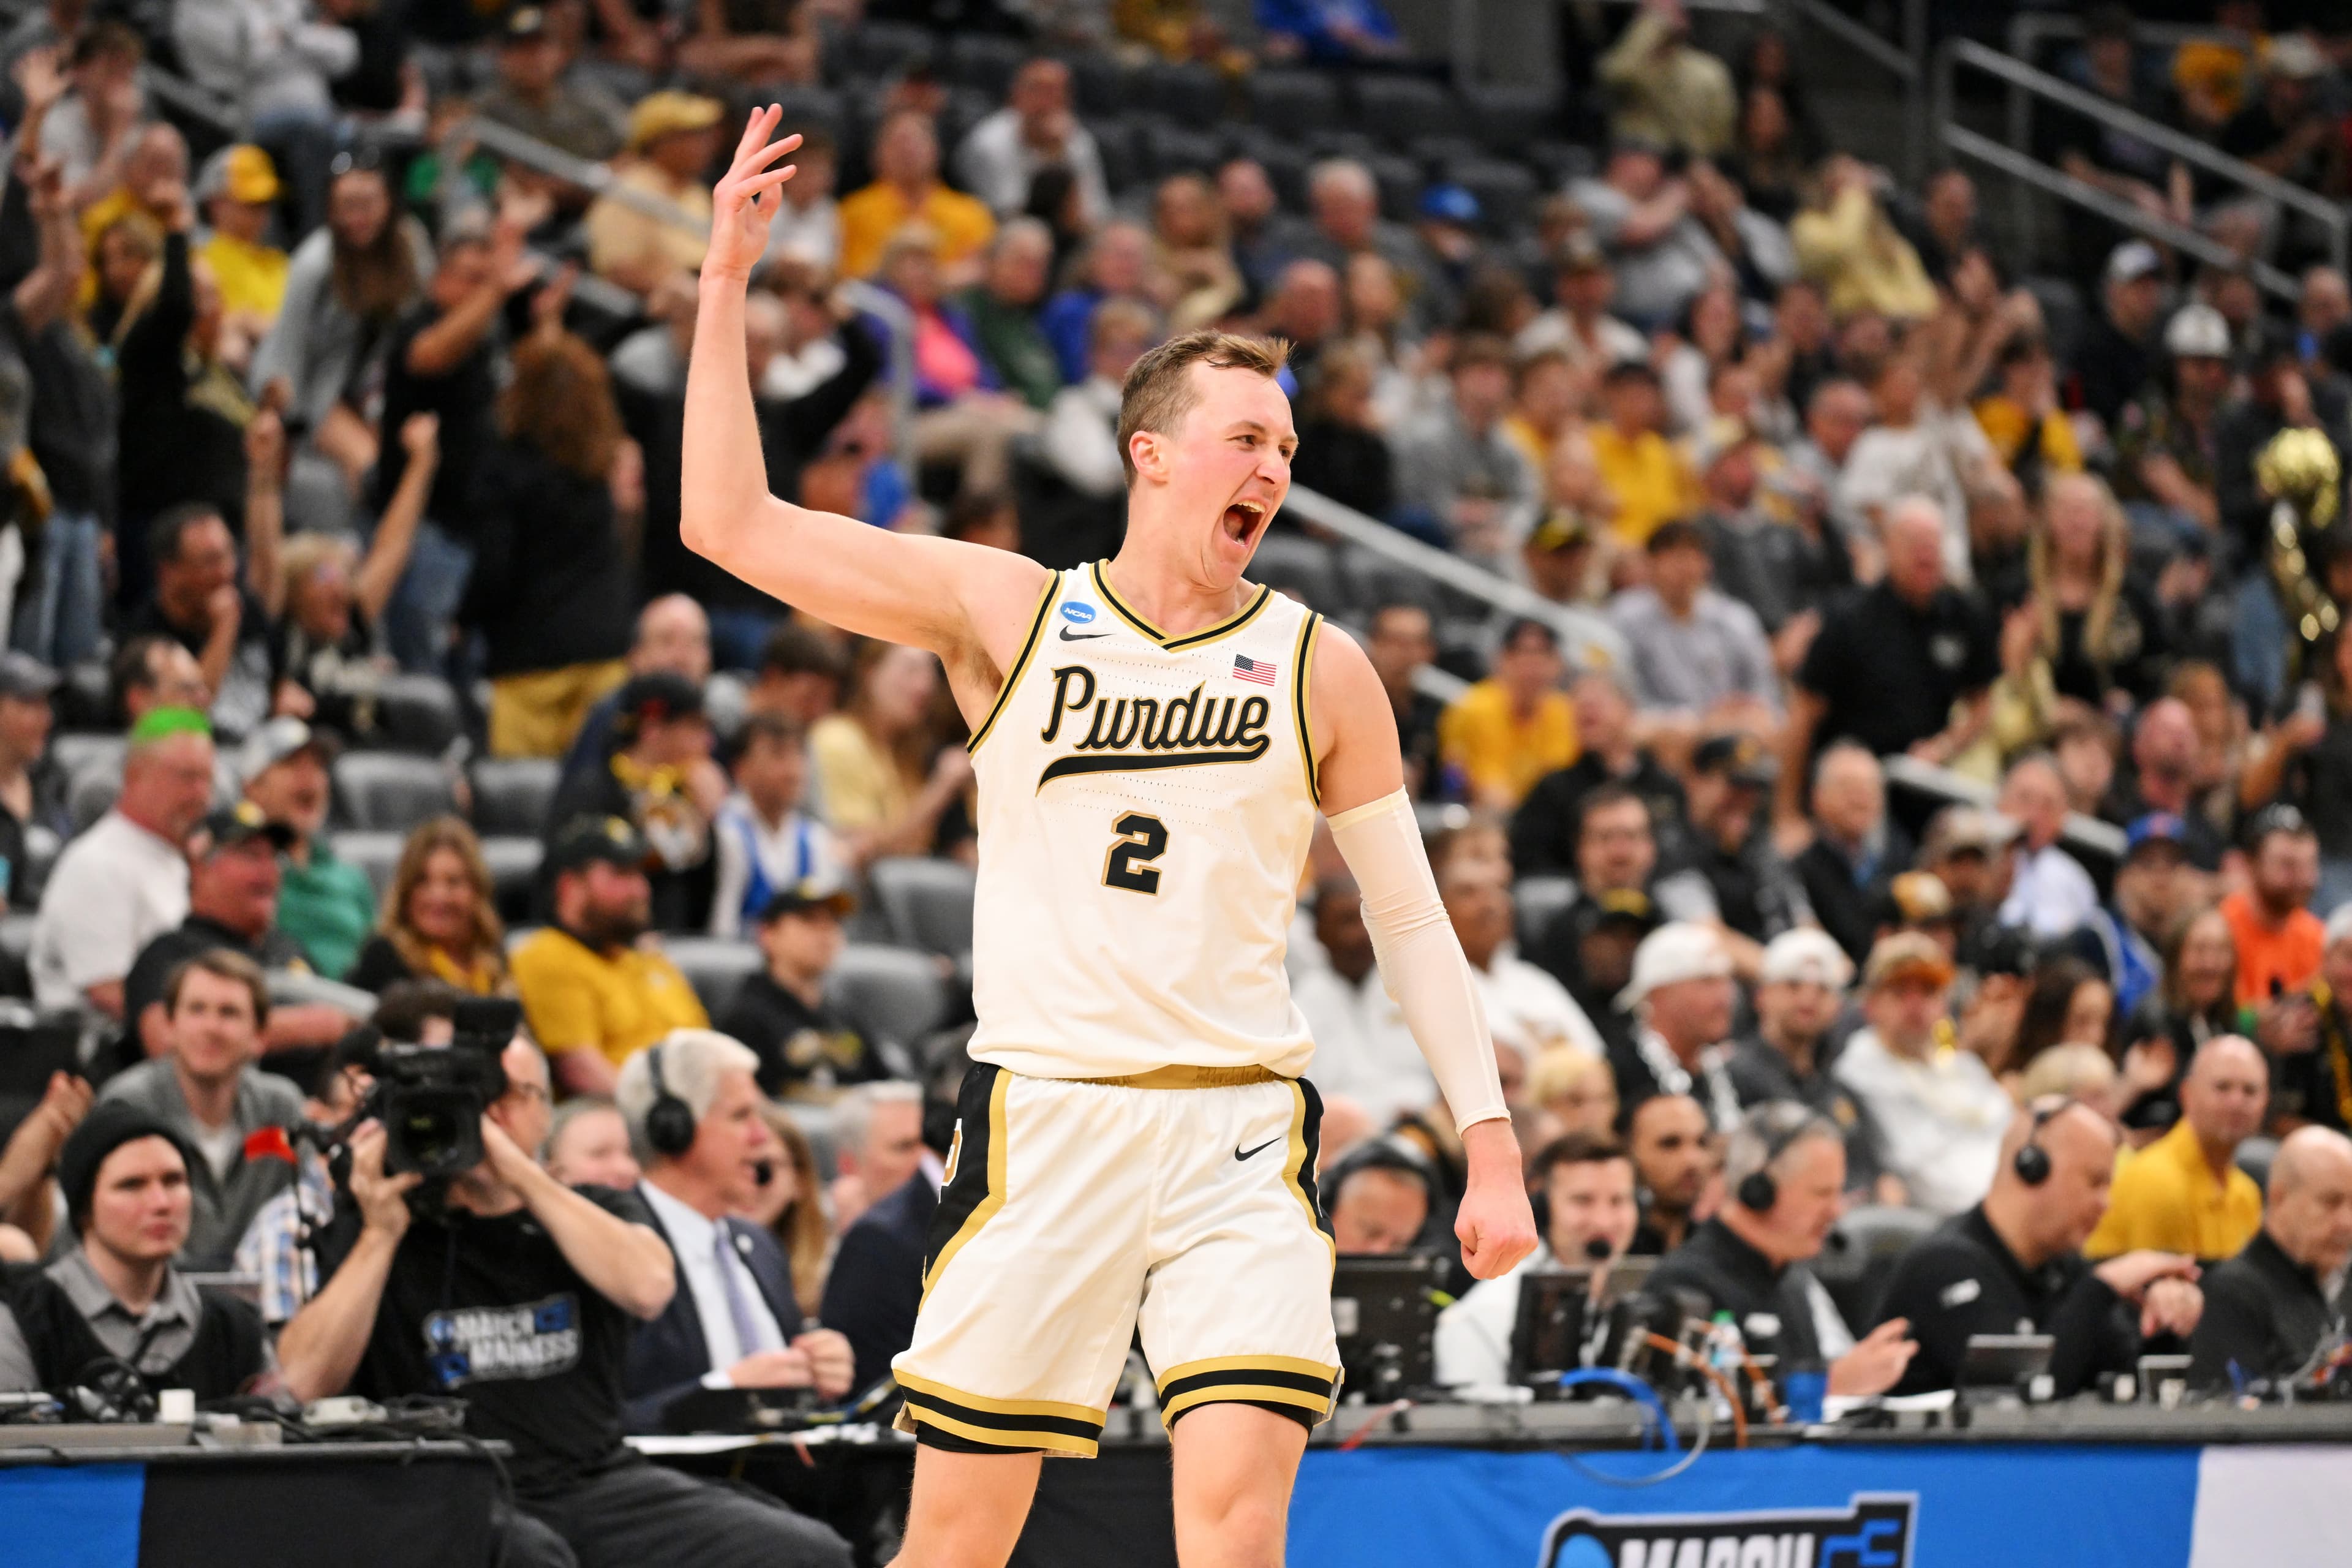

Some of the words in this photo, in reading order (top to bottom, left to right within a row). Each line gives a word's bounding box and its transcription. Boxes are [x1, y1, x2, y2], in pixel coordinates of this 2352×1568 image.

[1064, 607, 1093, 620] NCAA
[1039, 664, 1272, 760] Purdue
[1101, 810, 1170, 896] 2
